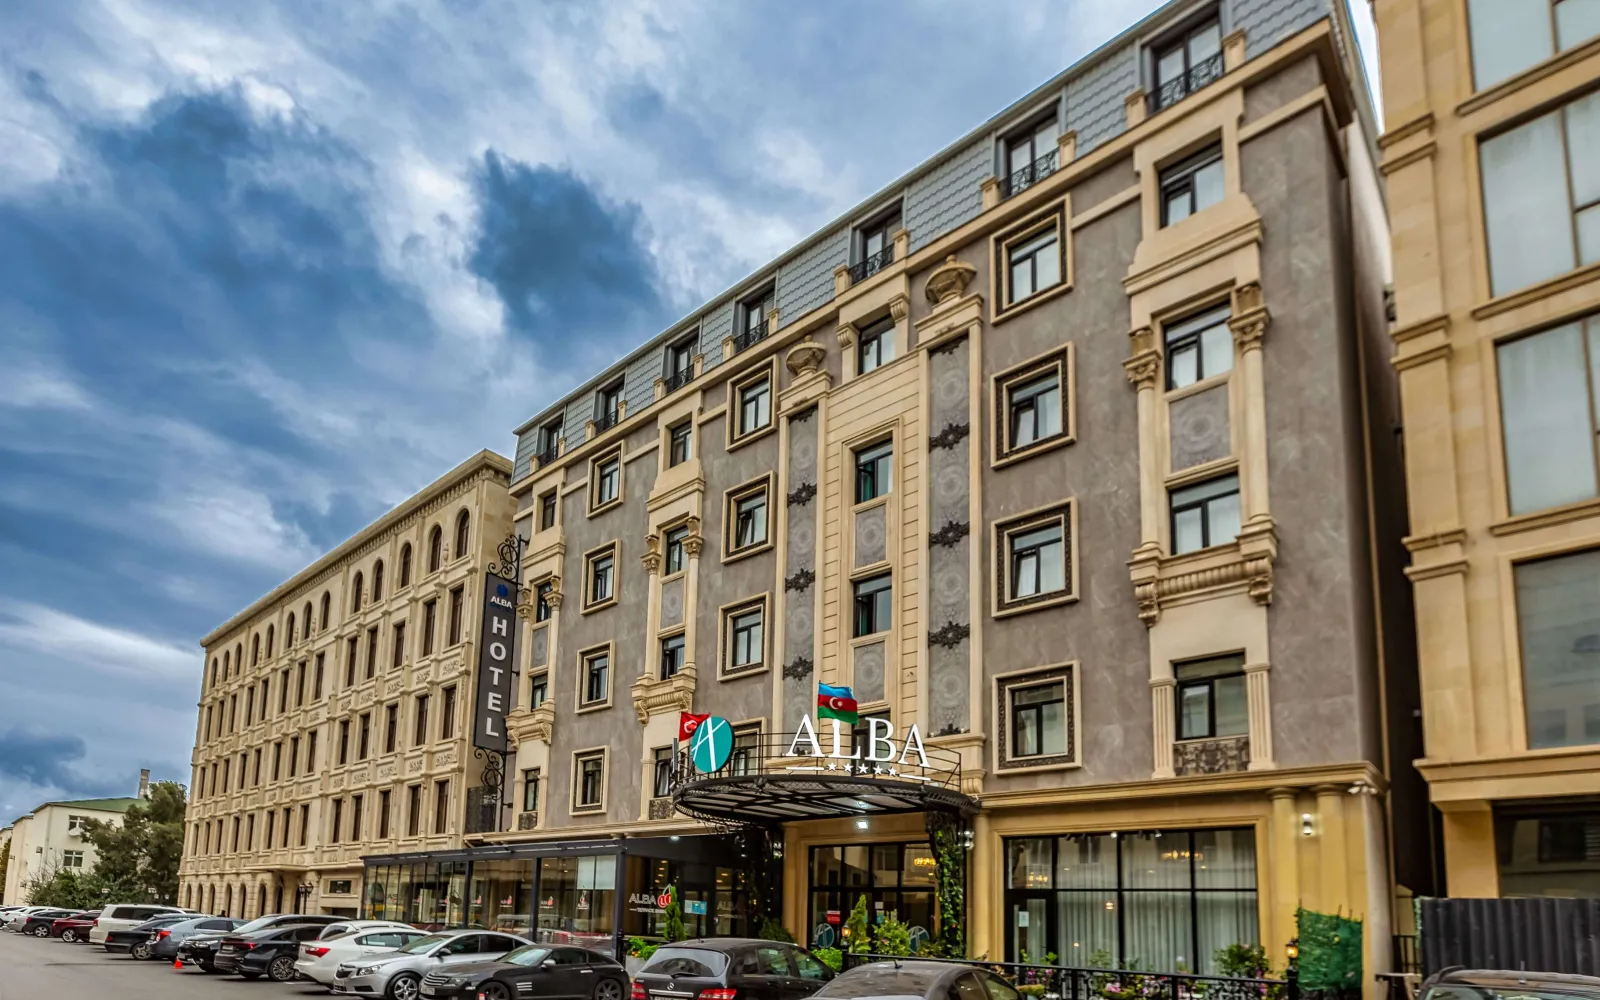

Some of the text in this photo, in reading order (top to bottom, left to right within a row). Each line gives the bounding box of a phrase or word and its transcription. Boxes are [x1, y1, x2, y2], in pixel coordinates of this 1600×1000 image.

[490, 595, 513, 610] ALBA
[485, 615, 508, 738] HOTEL
[785, 713, 932, 768] ALBA
